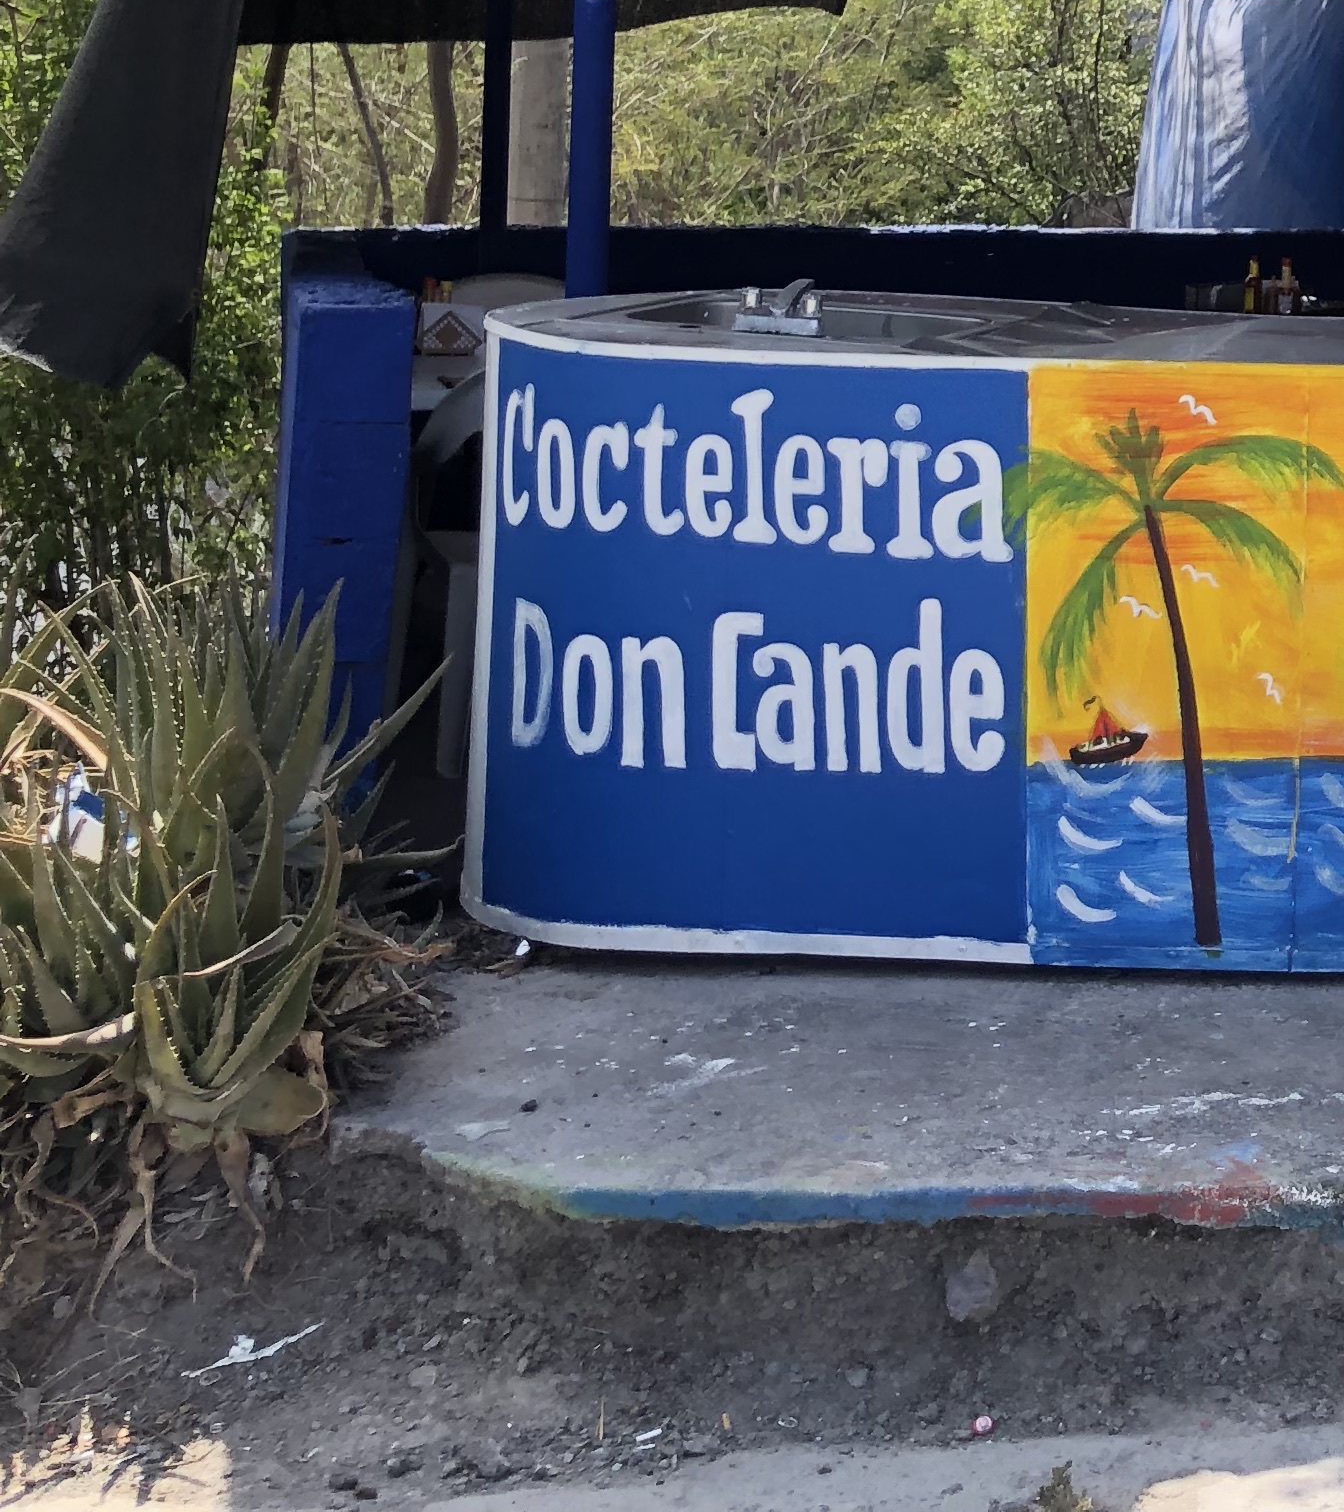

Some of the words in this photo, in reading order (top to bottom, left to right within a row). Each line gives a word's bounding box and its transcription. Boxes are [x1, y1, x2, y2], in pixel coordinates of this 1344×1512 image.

[502, 382, 1014, 563] Cocteleria
[510, 596, 687, 769] Don
[710, 597, 1005, 773] Cande
